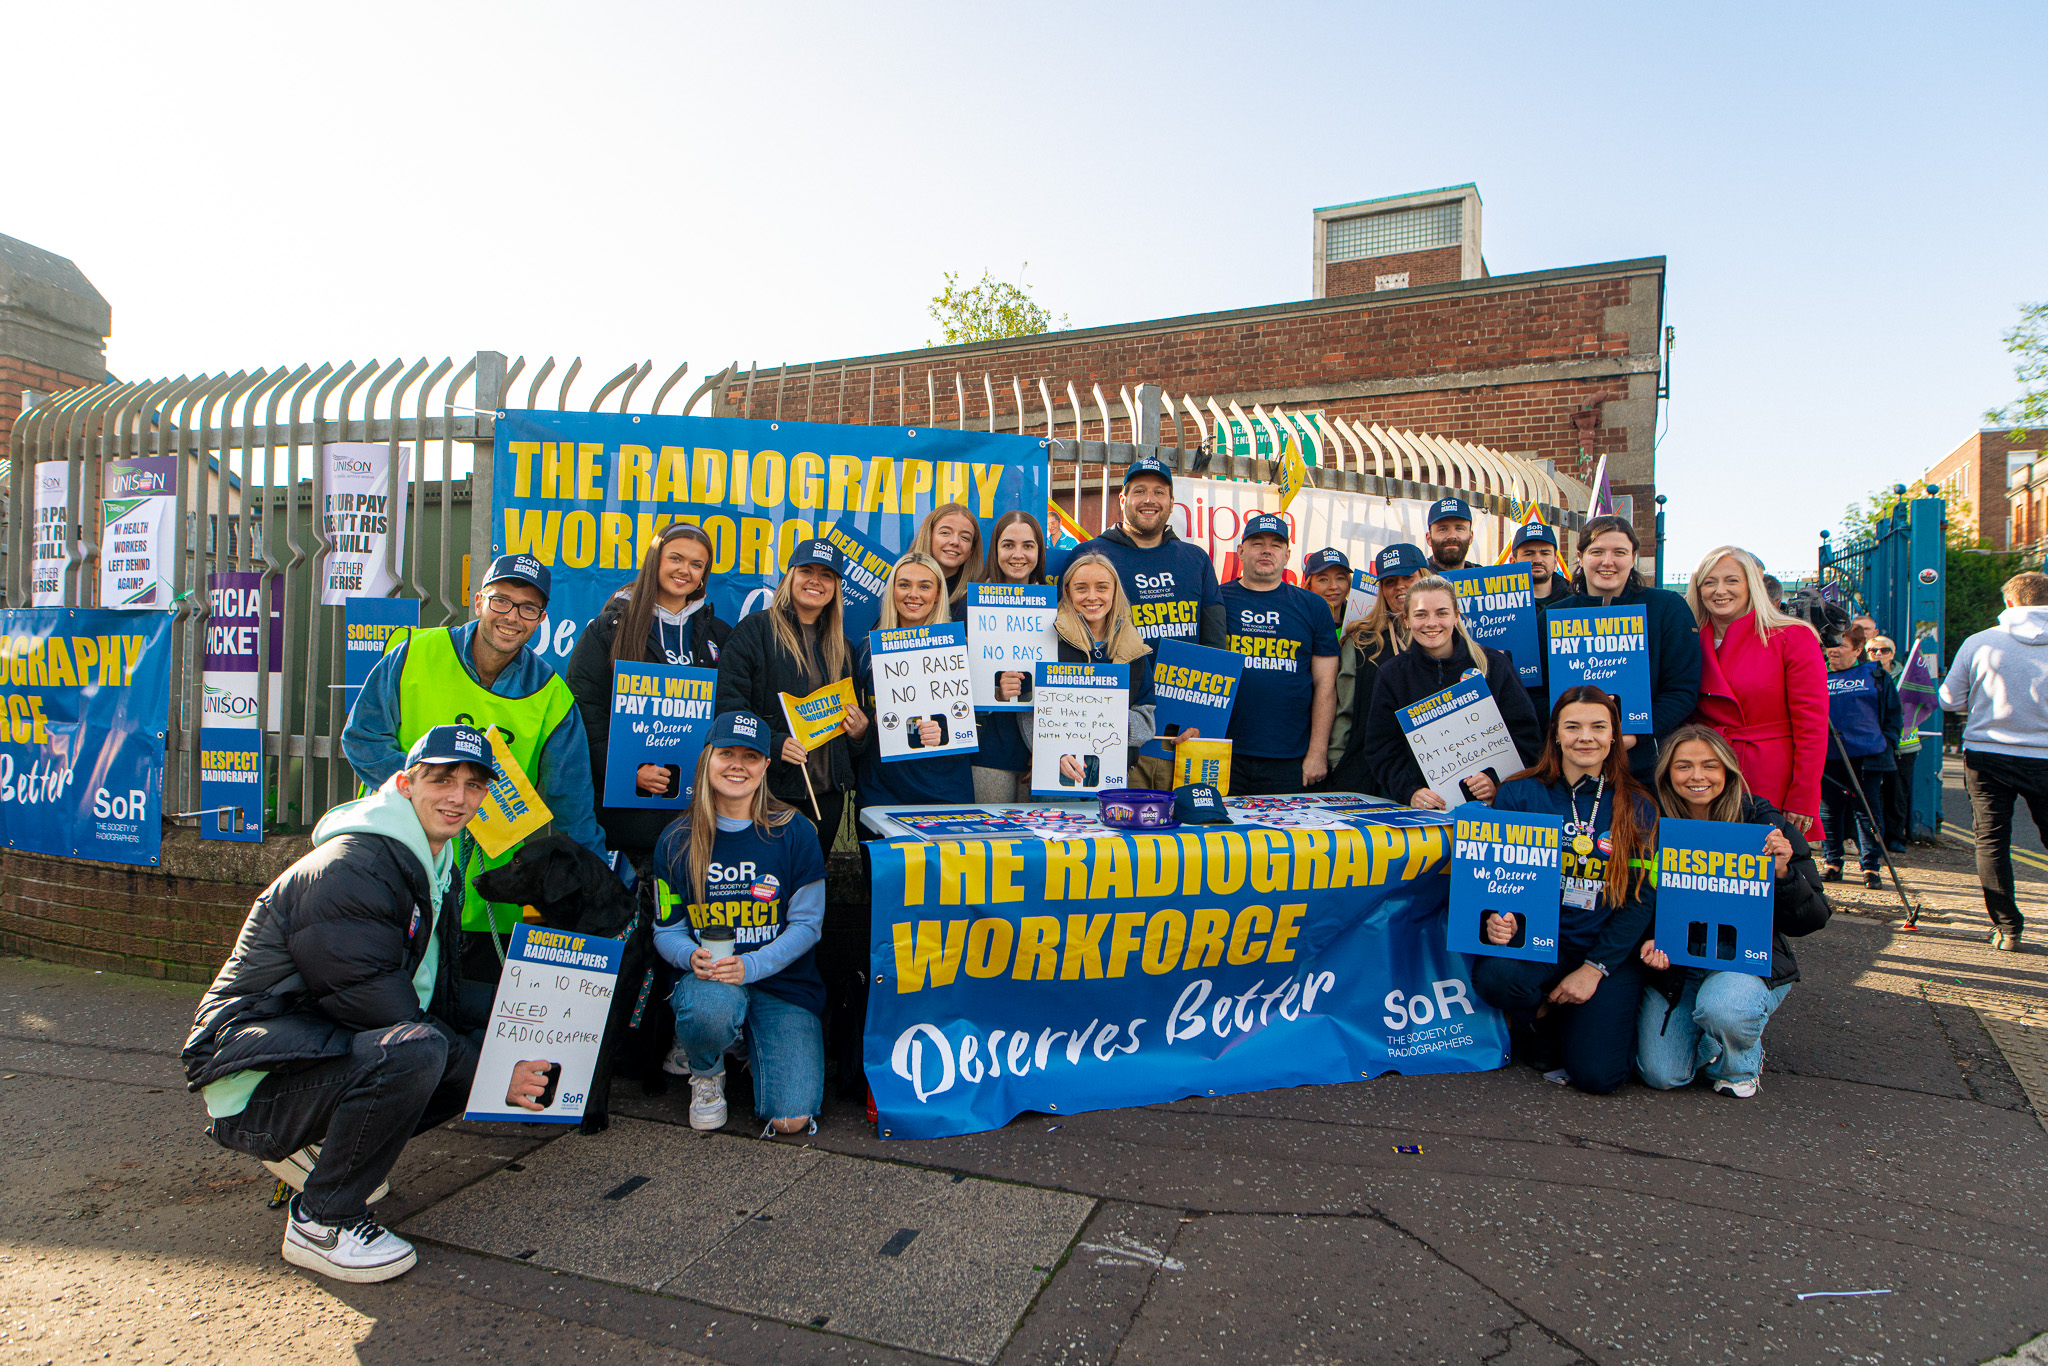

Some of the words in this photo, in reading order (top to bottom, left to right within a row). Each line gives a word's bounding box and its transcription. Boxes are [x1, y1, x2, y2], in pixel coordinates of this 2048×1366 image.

[333, 459, 372, 473] UNISON
[1142, 458, 1160, 466] SoR
[112, 472, 166, 493] UNISN
[508, 441, 603, 500] THE
[618, 444, 1004, 518] RADIOGRAPHY
[332, 493, 353, 512] OUR
[356, 494, 388, 513] PAY
[114, 523, 121, 535] NI
[123, 522, 149, 535] HEALTH
[114, 540, 148, 554] WORKERS
[340, 534, 372, 553] WILL
[814, 542, 834, 554] SoR
[828, 528, 864, 562] DEAL
[861, 551, 894, 580] WIT
[1382, 549, 1399, 561] SoR
[108, 559, 123, 572] LEFT
[125, 558, 150, 572] BEHIND
[516, 556, 540, 571] SoR
[39, 580, 58, 593] RISE
[117, 577, 144, 591] AGAIN?
[339, 576, 363, 590] RISE
[1134, 572, 1175, 589] SoR
[1484, 573, 1530, 594] WITH
[978, 585, 1013, 596] SOCIETY
[1014, 587, 1024, 596] OF
[208, 588, 280, 618] FFICIAL
[978, 595, 1047, 606] RADIOGRAPHERS
[1475, 590, 1532, 612] TODAY!
[1131, 601, 1199, 626] ESPECT
[1240, 609, 1280, 625] SoR
[1480, 613, 1517, 627] Deserve
[978, 614, 997, 632] NO
[1006, 614, 1043, 632] RAISE
[1550, 619, 1592, 638] DEAL
[1594, 616, 1643, 635] WITH
[880, 629, 918, 642] SOCIETY
[919, 628, 930, 637] OF
[1476, 626, 1507, 639] Better
[882, 635, 955, 651] RADIOGRAPHERS
[1550, 637, 1580, 654] PAY
[1583, 634, 1644, 653] TODAY!
[983, 645, 1004, 660] NO
[1012, 645, 1043, 661] RAYS
[884, 660, 910, 679] NO
[922, 654, 965, 674] RAISE
[1046, 665, 1082, 675] SOCIETY
[1084, 666, 1095, 676] OF
[1519, 666, 1538, 675] SoR
[1568, 658, 1585, 670] We
[1588, 656, 1627, 669] Deserve
[1046, 675, 1118, 687] RADIOGRAPHERS
[1154, 662, 1236, 697] RESPECT
[1583, 669, 1616, 681] Better
[616, 673, 661, 697] DEAL
[664, 677, 713, 700] WITH
[892, 685, 916, 704] NO
[930, 679, 969, 700] RAYS
[1827, 679, 1865, 690] NISON
[794, 697, 830, 716] SOCIETY
[830, 693, 841, 706] OF
[1038, 691, 1113, 704] STORMONT
[1407, 695, 1442, 718] SOCIETY
[1442, 690, 1453, 702] OF
[615, 694, 648, 715] PAY
[651, 697, 712, 719] TODAY!
[1037, 706, 1053, 716] WE
[1060, 708, 1087, 717] HAVE
[1411, 689, 1480, 727] RADIOGRAPHERS
[735, 715, 758, 729] SoR
[1628, 712, 1648, 720] SoR
[632, 720, 649, 733] We
[652, 720, 693, 734] Deserve
[955, 731, 973, 739] SoR
[1412, 733, 1427, 745] 9
[1440, 729, 1450, 737] in
[1464, 712, 1480, 725] 10
[456, 731, 482, 747] SoR
[645, 733, 681, 747] Better
[1418, 734, 1478, 764] PATIENTS
[1480, 722, 1504, 738] NEED
[201, 750, 259, 771] RESPECT
[1427, 736, 1511, 782] RADIOGRAPHER
[1456, 751, 1462, 759] A
[201, 769, 259, 783] RADIOGRAPHY
[1105, 776, 1123, 784] SoR
[1192, 788, 1212, 797] SoR
[93, 787, 146, 821] SoR
[512, 798, 530, 816] OF
[96, 822, 107, 831] THE
[107, 823, 130, 832] SOCIETY
[130, 824, 138, 833] OF
[246, 823, 259, 831] SoR
[1456, 819, 1502, 843] DEAL
[1505, 824, 1559, 848] WITH
[96, 832, 140, 843] RADIOGRAPHERS
[1455, 840, 1489, 861] PAY
[1492, 843, 1558, 868] TODAY!
[1662, 847, 1772, 880] RESPECT
[707, 861, 756, 883] SoR
[890, 840, 1025, 906] THE
[1473, 867, 1491, 880] We
[1494, 866, 1538, 881] Deserve
[1487, 880, 1525, 894] Better
[1661, 872, 1771, 897] RADIOGRAPHY
[687, 899, 780, 929] RESPECT
[527, 929, 570, 949] SOCIETY
[571, 938, 586, 951] OF
[1532, 936, 1554, 948] SoR
[523, 943, 608, 969] RADIOGRAPHERS
[892, 903, 1307, 994] WORKFORCE
[1744, 949, 1768, 961] SoR
[510, 966, 522, 988] 9
[529, 980, 540, 989] in
[555, 975, 570, 991] 10
[579, 979, 612, 999] PEOPLE
[500, 1000, 548, 1018] NEED
[563, 1007, 571, 1018] A
[1383, 978, 1475, 1030] SoR
[496, 1022, 599, 1045] RADIOGRAPHER
[891, 1018, 1147, 1103] Deserves
[1165, 971, 1336, 1045] Better
[1386, 1035, 1406, 1045] THE
[1406, 1026, 1447, 1043] SOCIETY
[1449, 1023, 1464, 1035] OF
[1388, 1035, 1474, 1058] RADIOGRAPHERS
[562, 1093, 584, 1104] SoR
